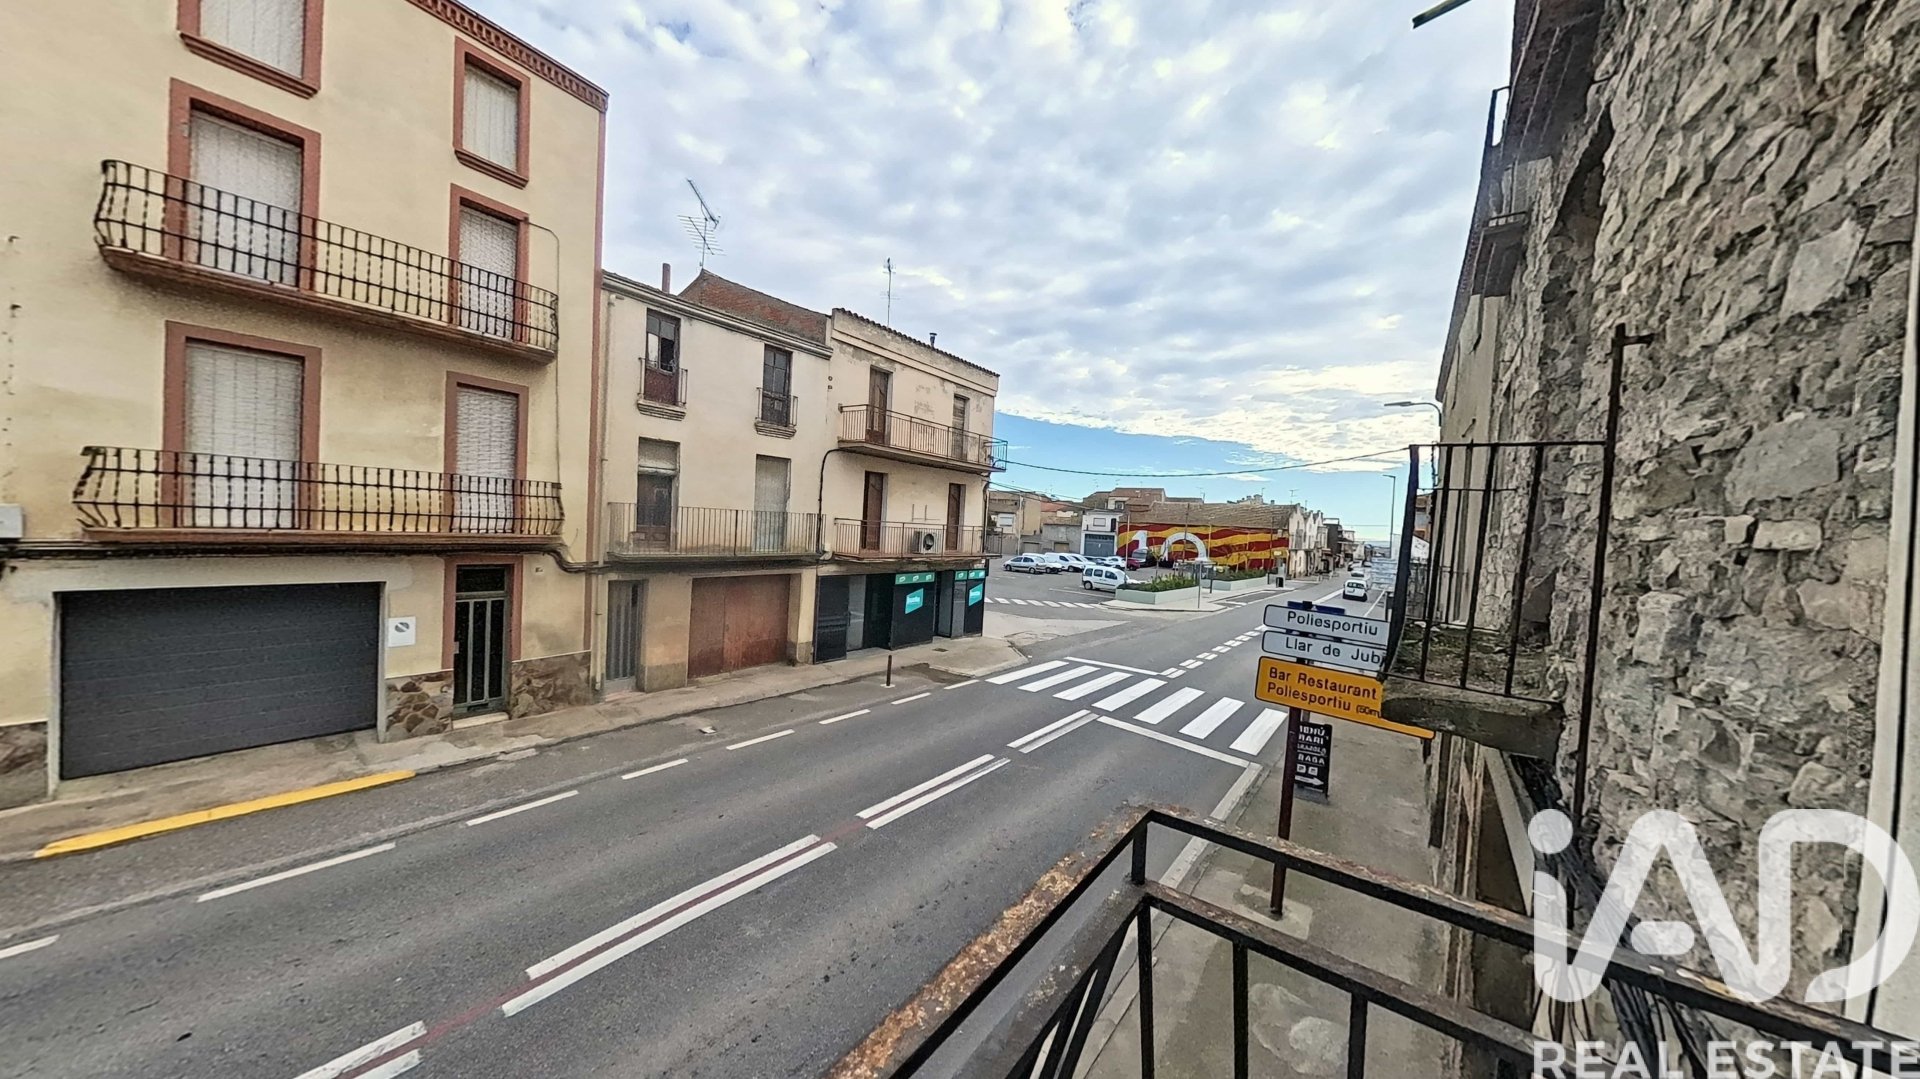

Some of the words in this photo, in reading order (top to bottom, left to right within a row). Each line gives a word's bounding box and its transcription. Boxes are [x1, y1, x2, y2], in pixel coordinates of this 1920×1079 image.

[1287, 610, 1378, 636] Poliesportiu
[1285, 637, 1313, 653] Llar
[1322, 644, 1341, 657] de
[1267, 681, 1351, 711] Poliesportiu
[1269, 666, 1291, 682] Bar
[1297, 672, 1377, 700] Restaurant
